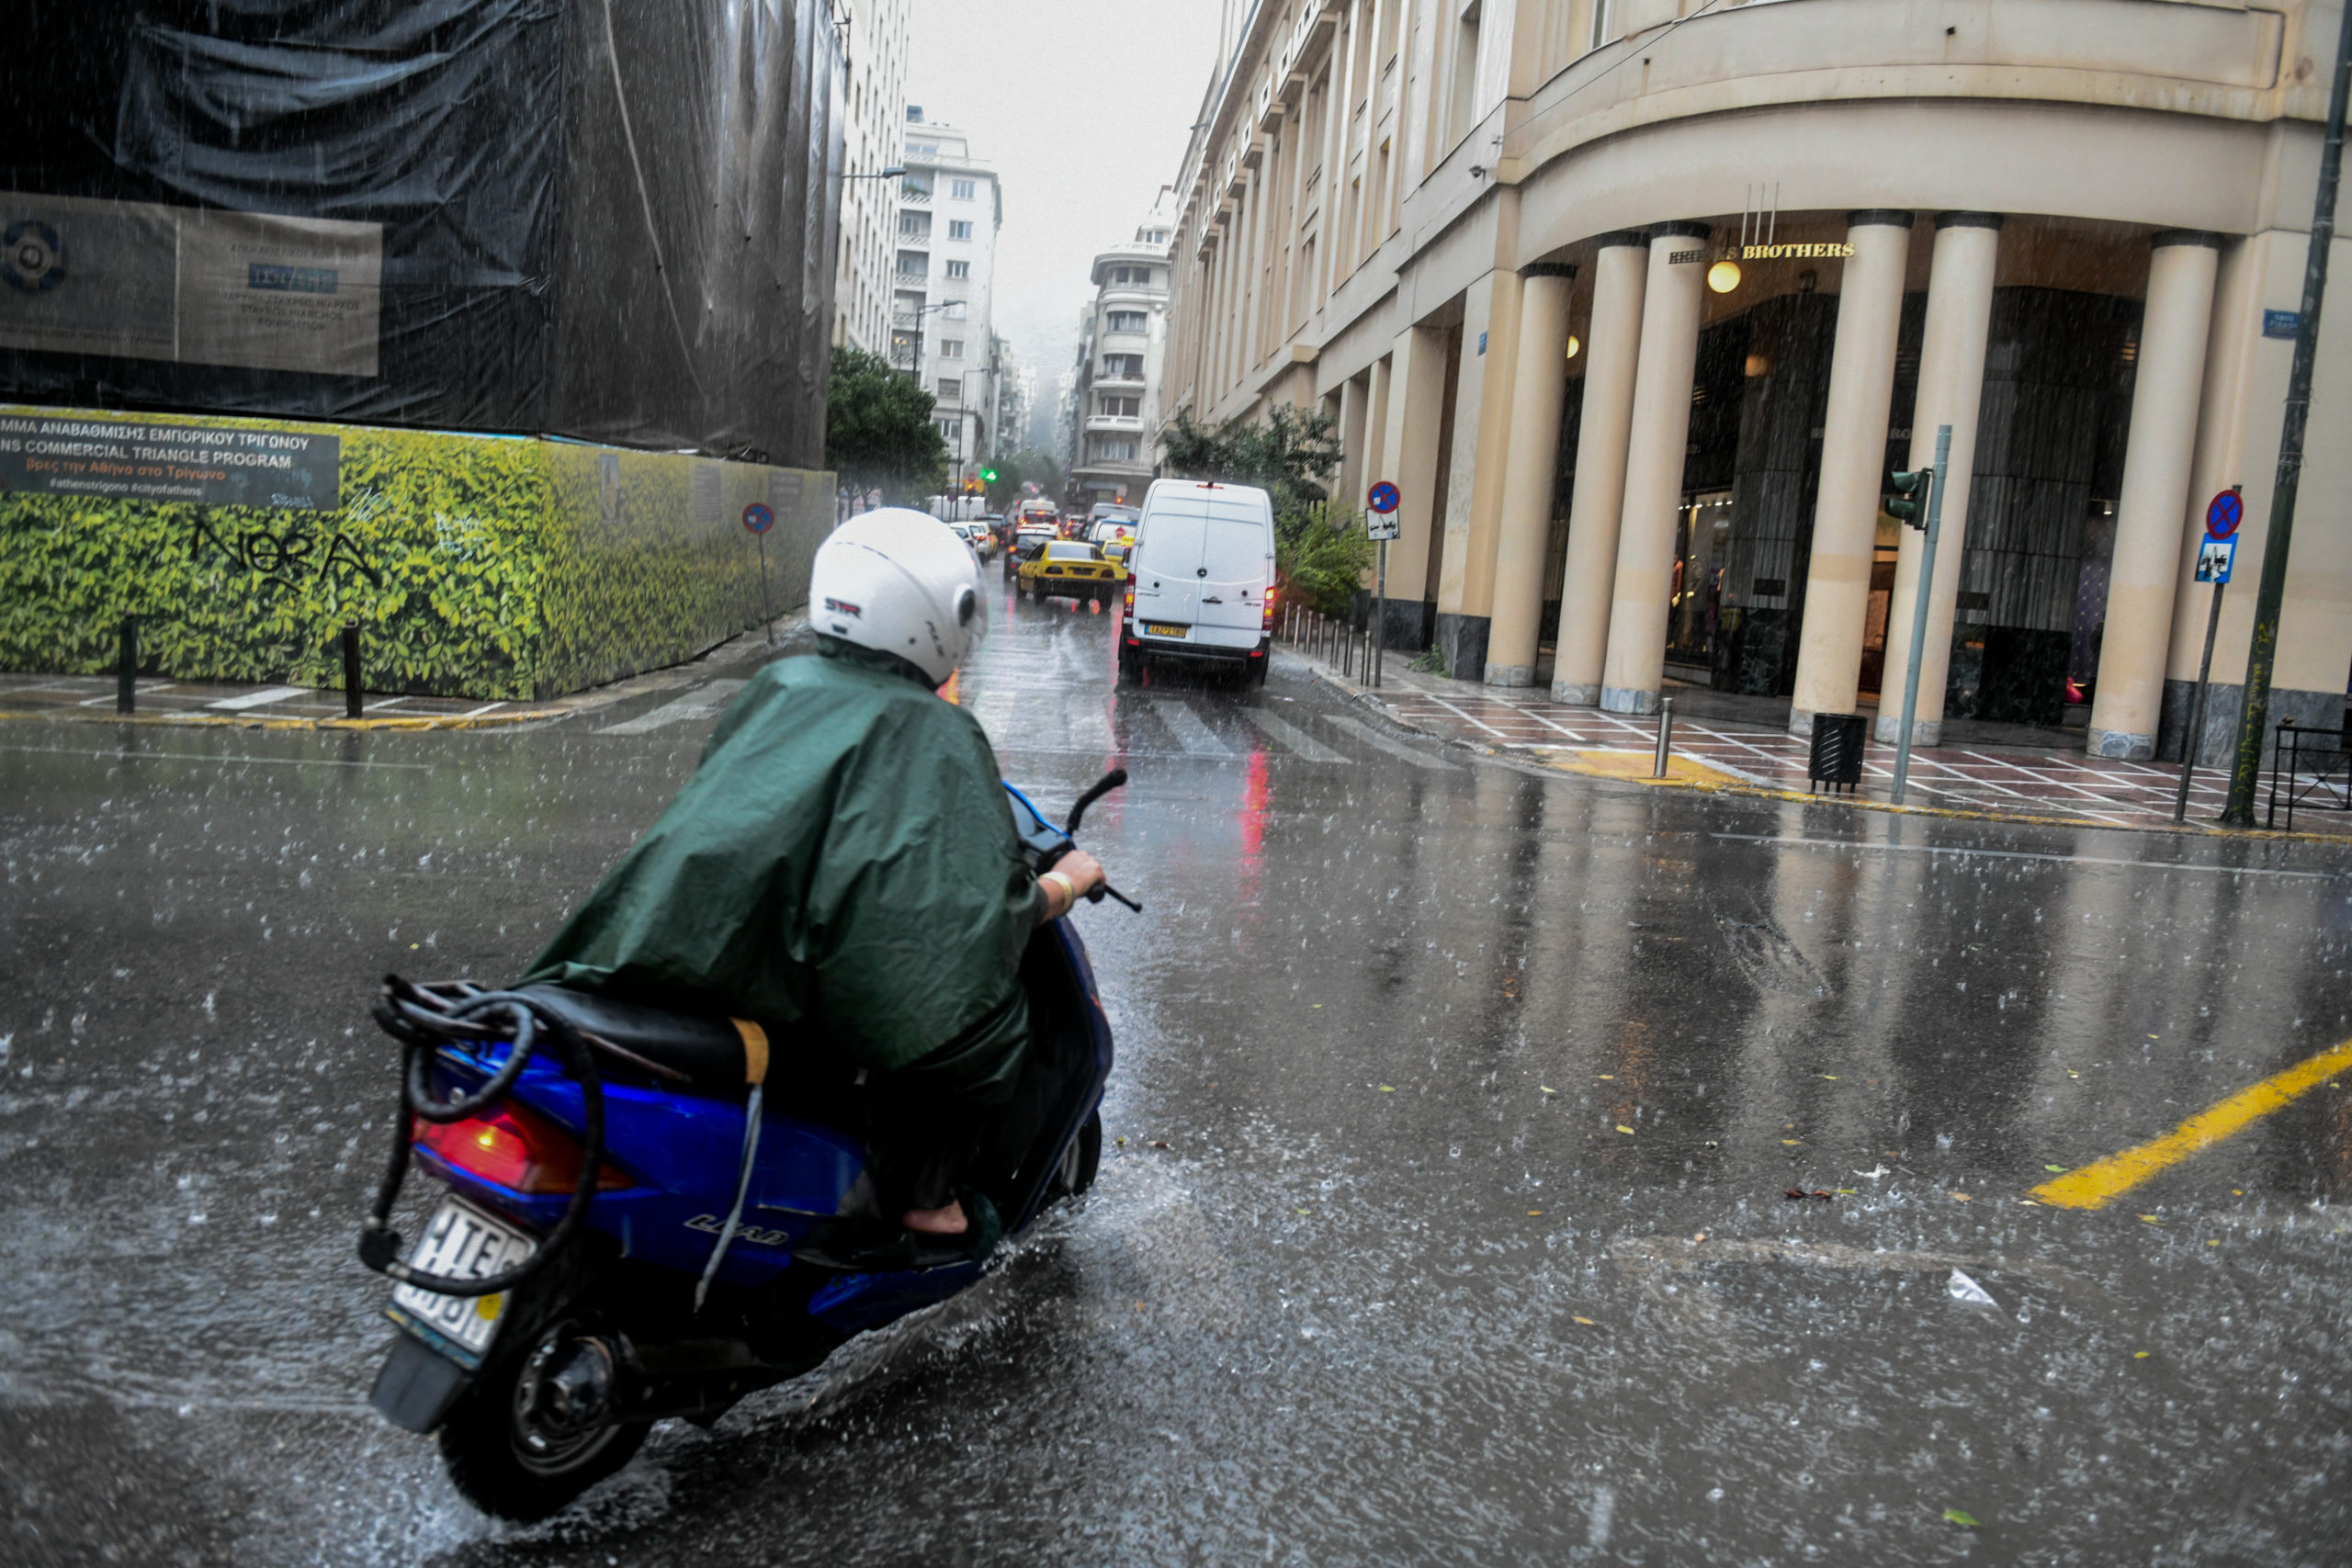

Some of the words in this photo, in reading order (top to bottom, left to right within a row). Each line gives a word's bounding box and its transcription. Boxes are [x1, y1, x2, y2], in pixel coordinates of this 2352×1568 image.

[1742, 243, 1856, 260] BROTHERS
[40, 421, 146, 440] ΑΝΑΒΑΘΜΙΣΗΣ
[149, 428, 234, 446] ΕΜΠΟΡΙΚΟΥ
[237, 433, 310, 451] ΤΡΙΓΩΝΟΥ
[25, 440, 129, 459] COMMERCIAL
[132, 446, 209, 464] TRIANGLE
[212, 451, 292, 469] PROGRAM
